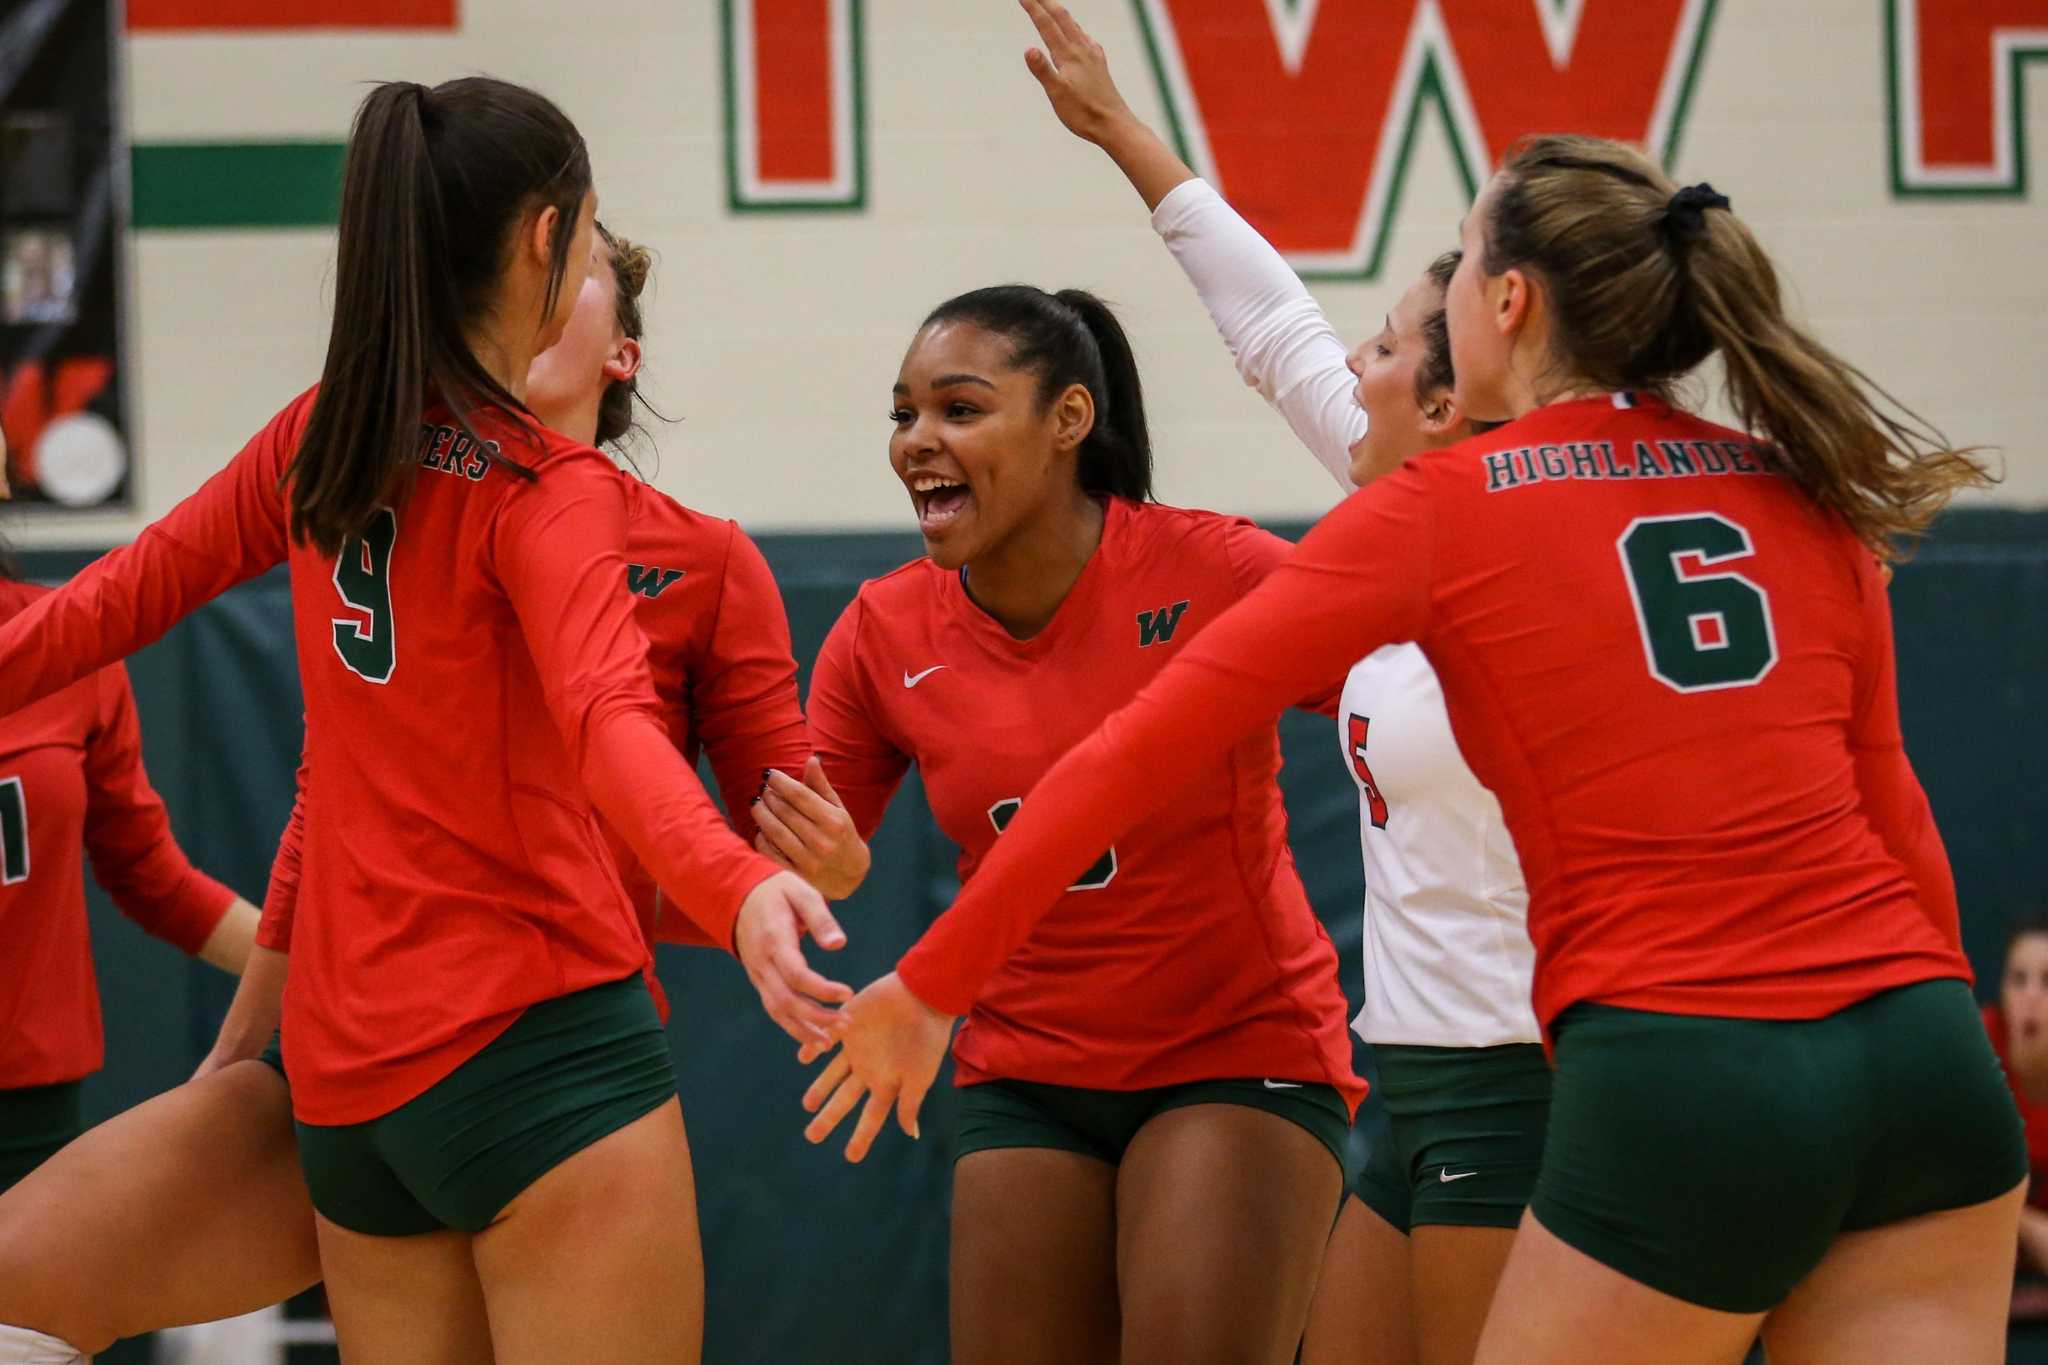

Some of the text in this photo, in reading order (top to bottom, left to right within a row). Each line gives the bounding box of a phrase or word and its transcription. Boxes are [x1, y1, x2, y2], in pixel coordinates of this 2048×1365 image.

[418, 423, 501, 482] ERS
[331, 505, 397, 685] 9
[1136, 599, 1191, 649] W
[1615, 511, 1781, 695] 6
[1347, 711, 1390, 831] 5
